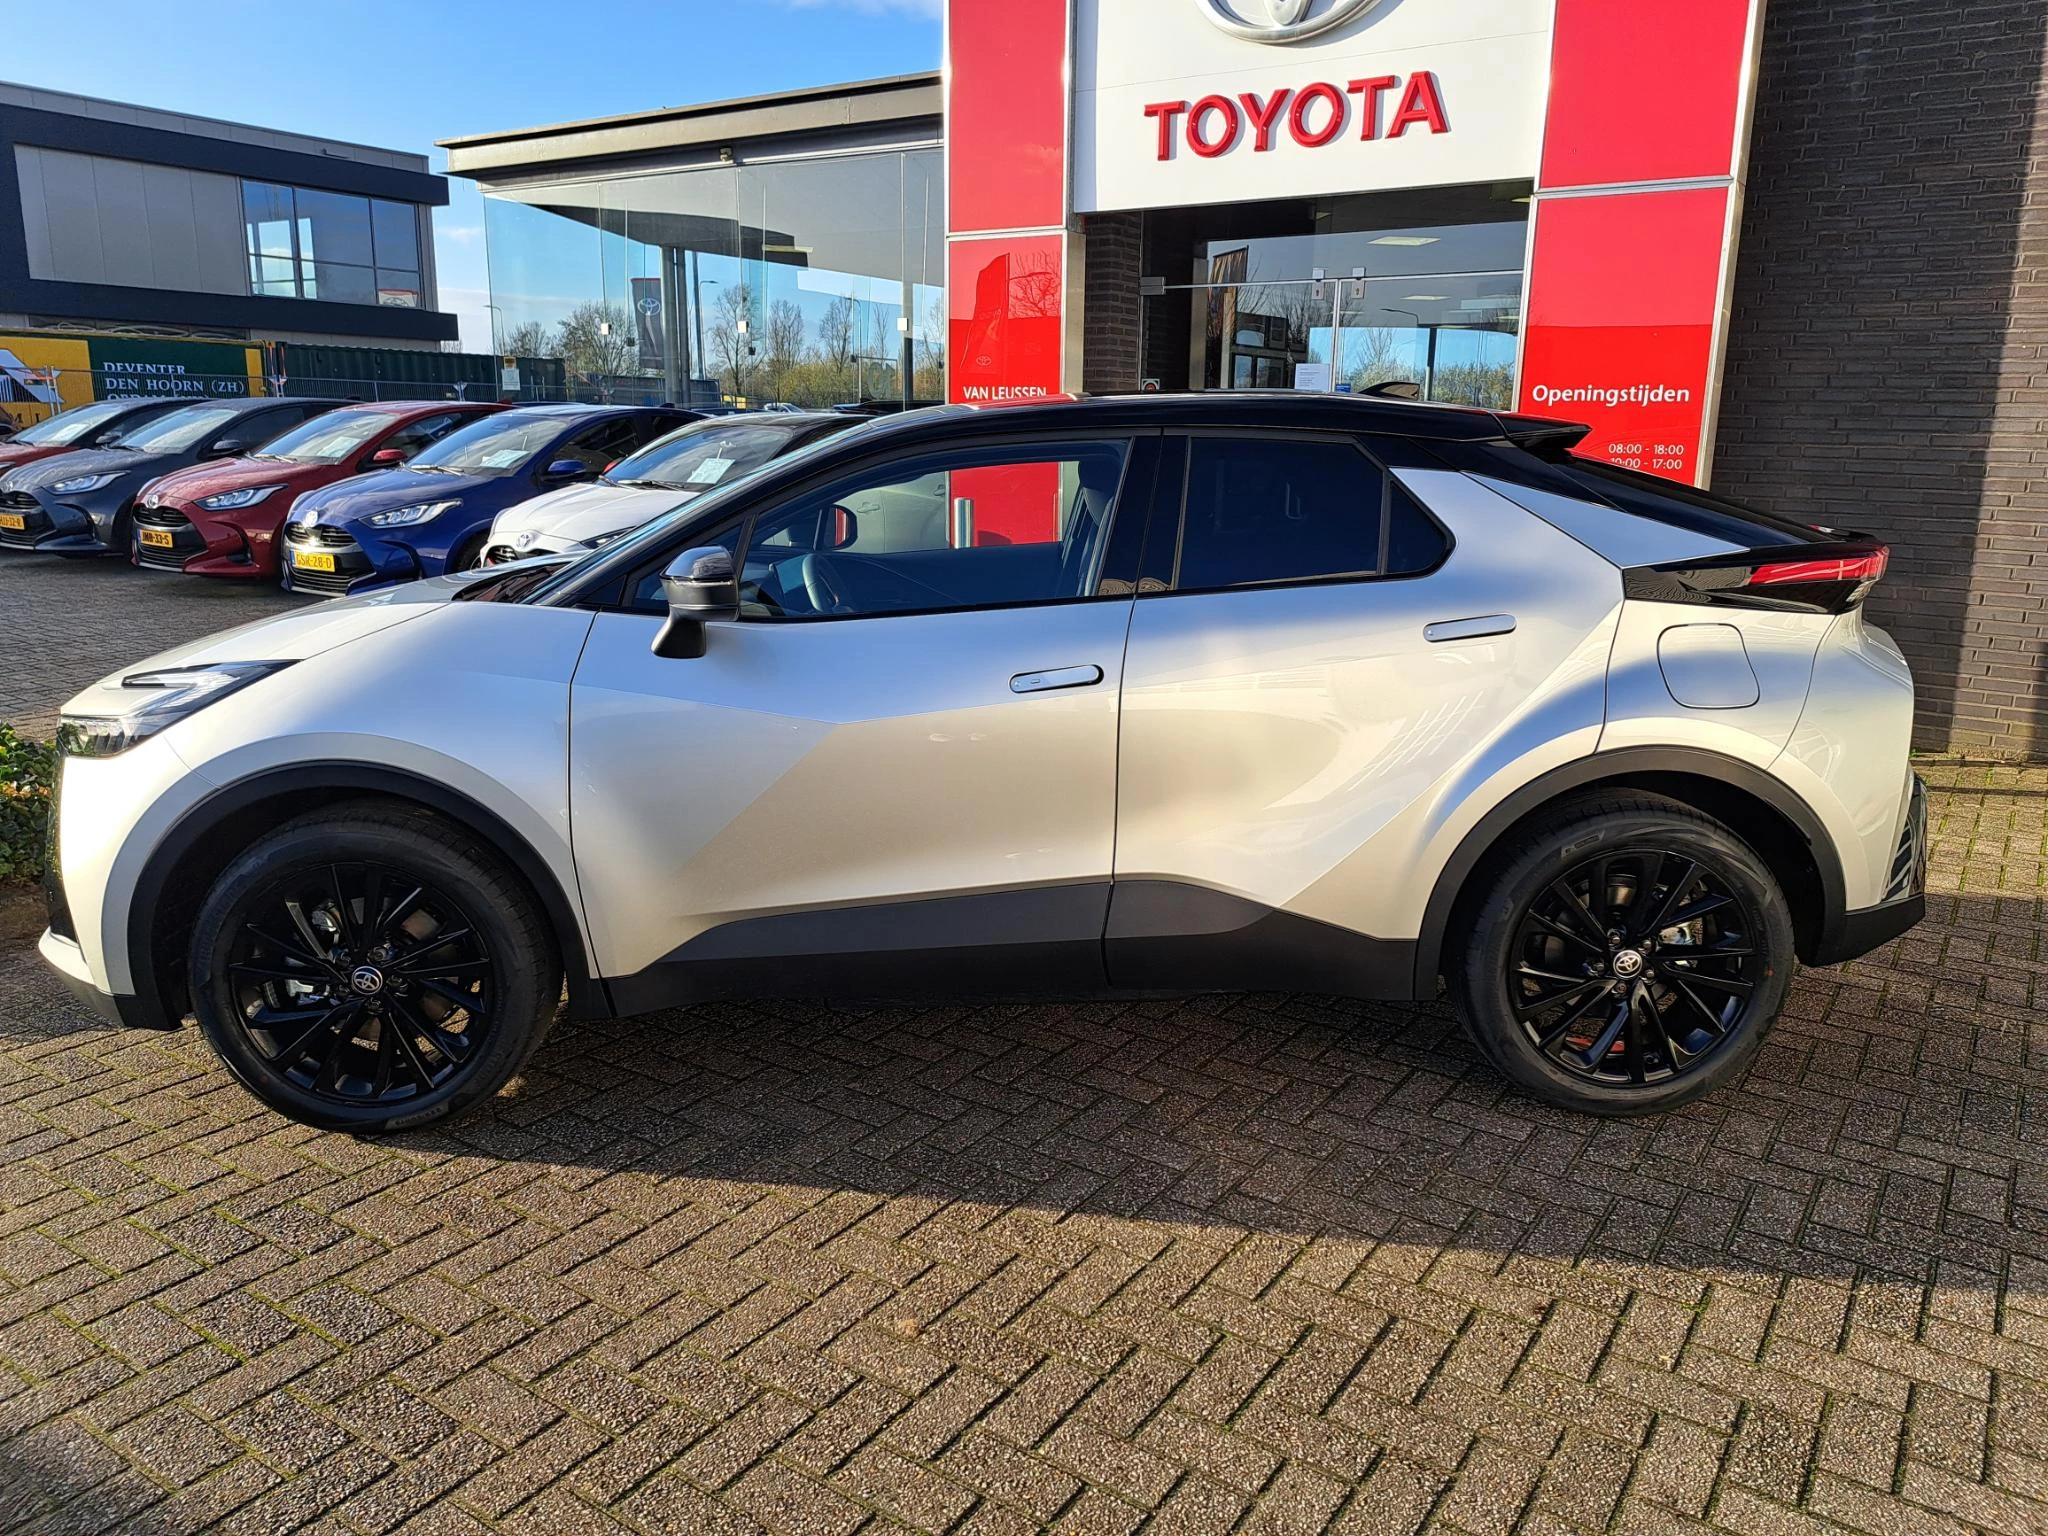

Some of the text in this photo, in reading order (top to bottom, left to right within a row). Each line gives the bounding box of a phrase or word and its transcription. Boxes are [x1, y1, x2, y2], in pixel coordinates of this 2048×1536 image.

[1144, 71, 1449, 161] TOYOTA
[103, 361, 185, 375] DEVENTER
[106, 378, 244, 394] DEN HOORN (ZH)
[963, 386, 1047, 400] VAN LEUSSEN
[1532, 384, 1690, 407] Openingstijden
[1608, 443, 1642, 454] 08:00
[1653, 444, 1685, 455] 18:00
[1652, 458, 1683, 470] 17:00
